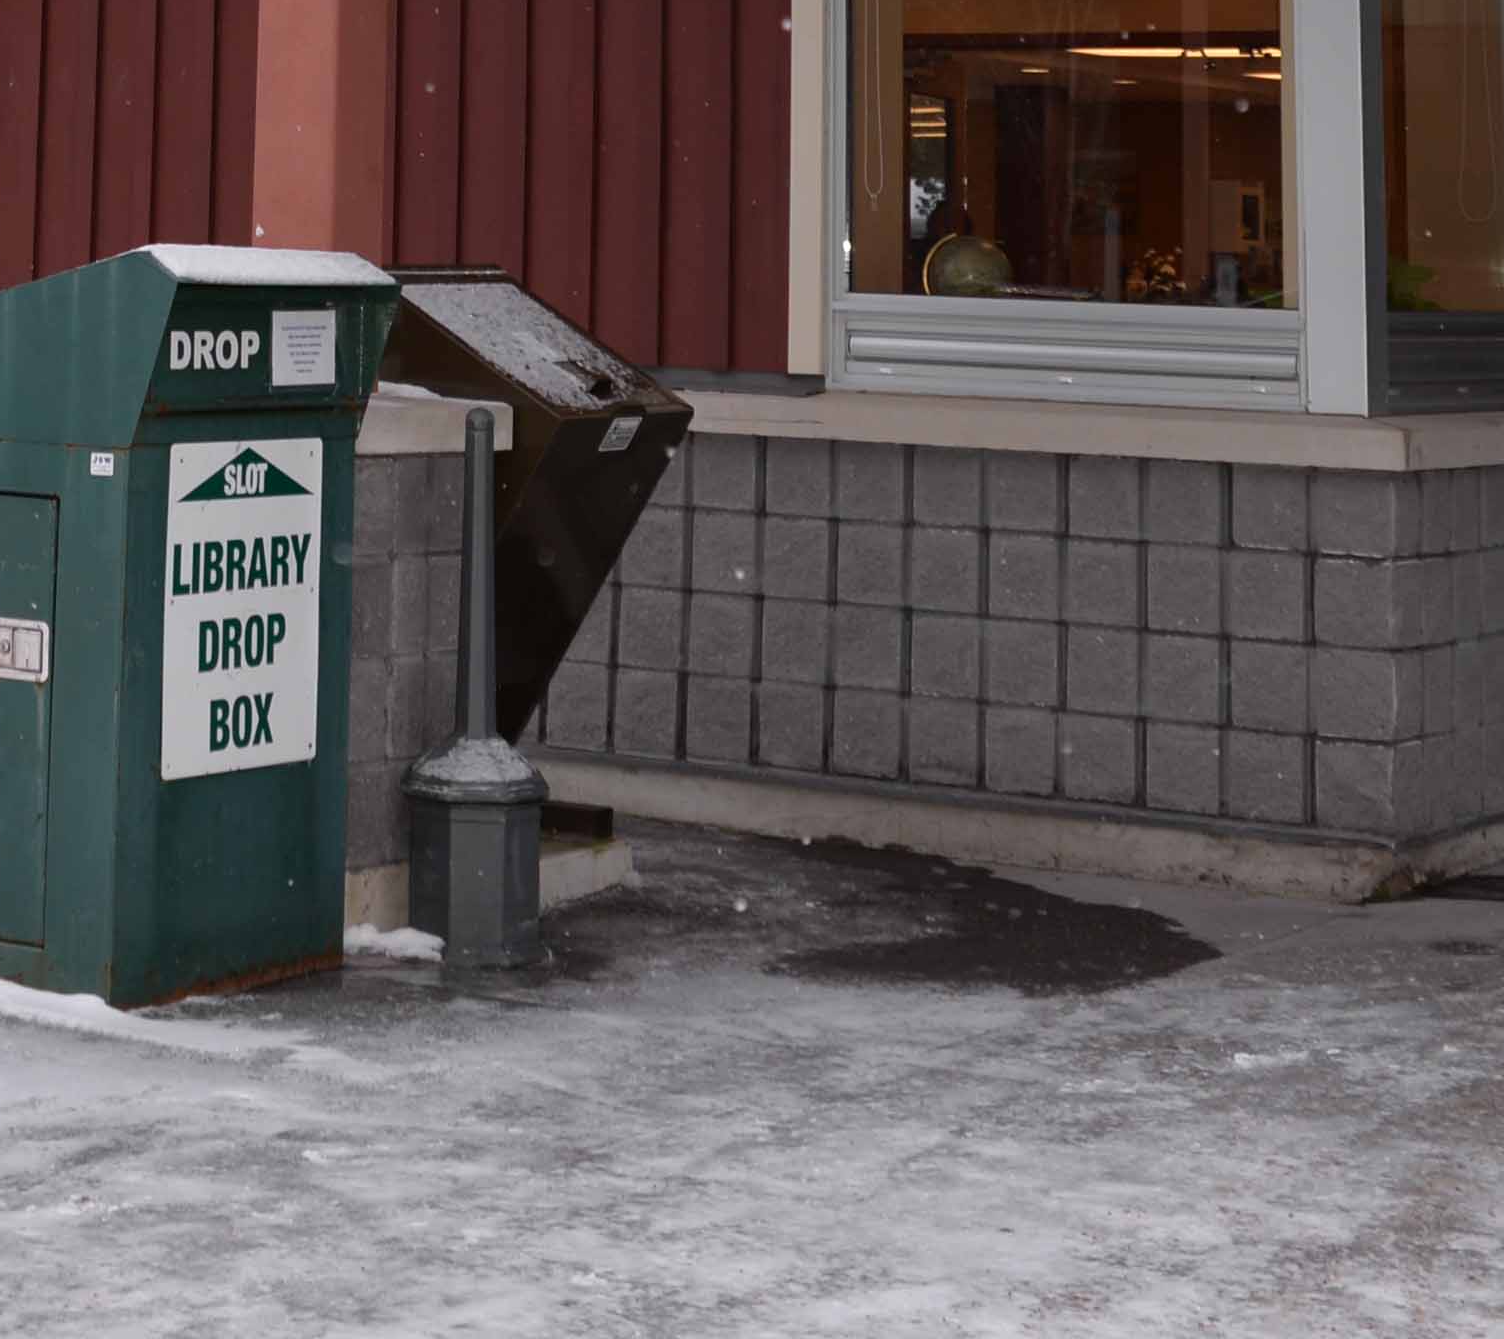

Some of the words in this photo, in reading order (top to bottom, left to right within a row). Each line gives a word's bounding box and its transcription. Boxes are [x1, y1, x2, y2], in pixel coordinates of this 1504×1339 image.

[169, 330, 260, 370] DROP
[223, 463, 268, 497] SLOT
[172, 533, 312, 596] LIBRARY
[198, 612, 286, 673] DROP
[209, 692, 274, 753] BOX
